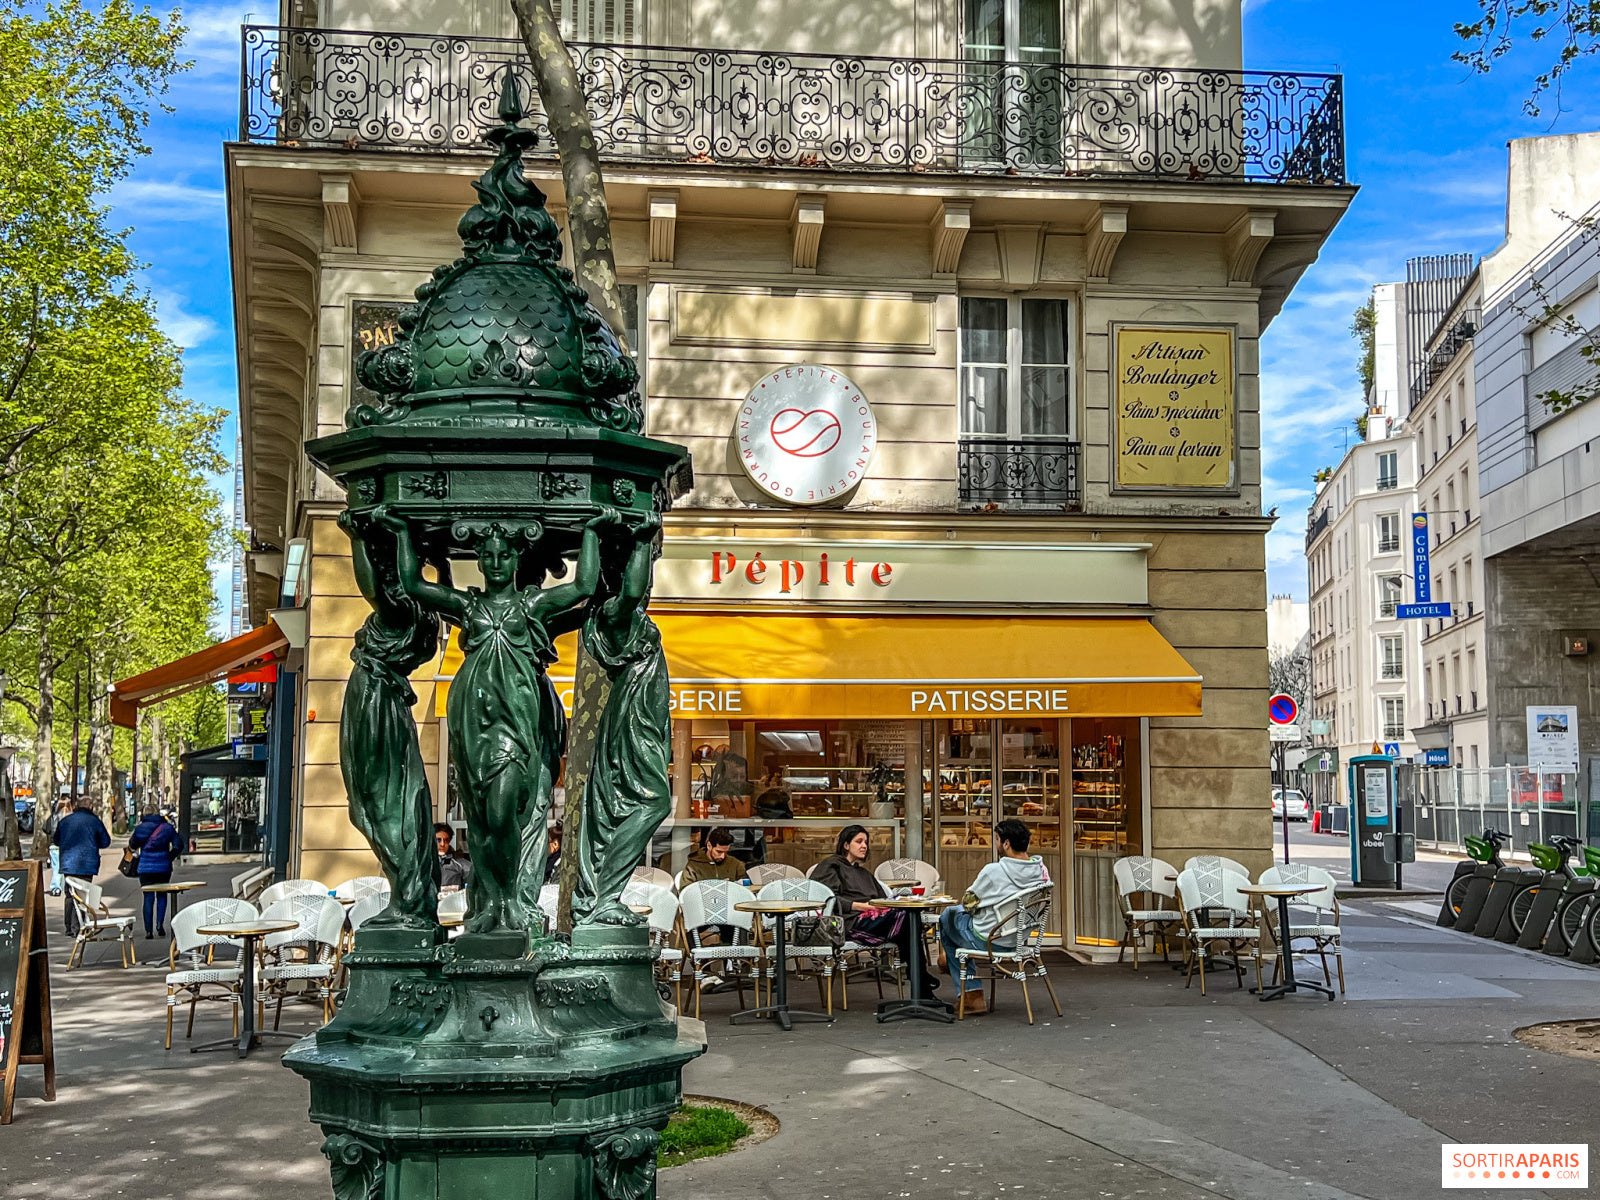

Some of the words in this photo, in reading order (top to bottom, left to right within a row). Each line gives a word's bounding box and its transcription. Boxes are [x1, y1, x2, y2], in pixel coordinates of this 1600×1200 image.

[1131, 341, 1207, 361] Artisan
[1122, 365, 1223, 390] Boulanger
[1121, 400, 1160, 419] Pains
[740, 394, 794, 498] GOURMANDE
[808, 394, 872, 500] BOULANGERIE
[1122, 436, 1158, 456] Pain
[1158, 445, 1176, 456] au
[1177, 440, 1225, 457] levain
[710, 551, 894, 594] Pépite
[1416, 535, 1427, 598] Comfort
[1406, 606, 1441, 616] HOTEL
[911, 689, 1069, 712] PATISSERIE
